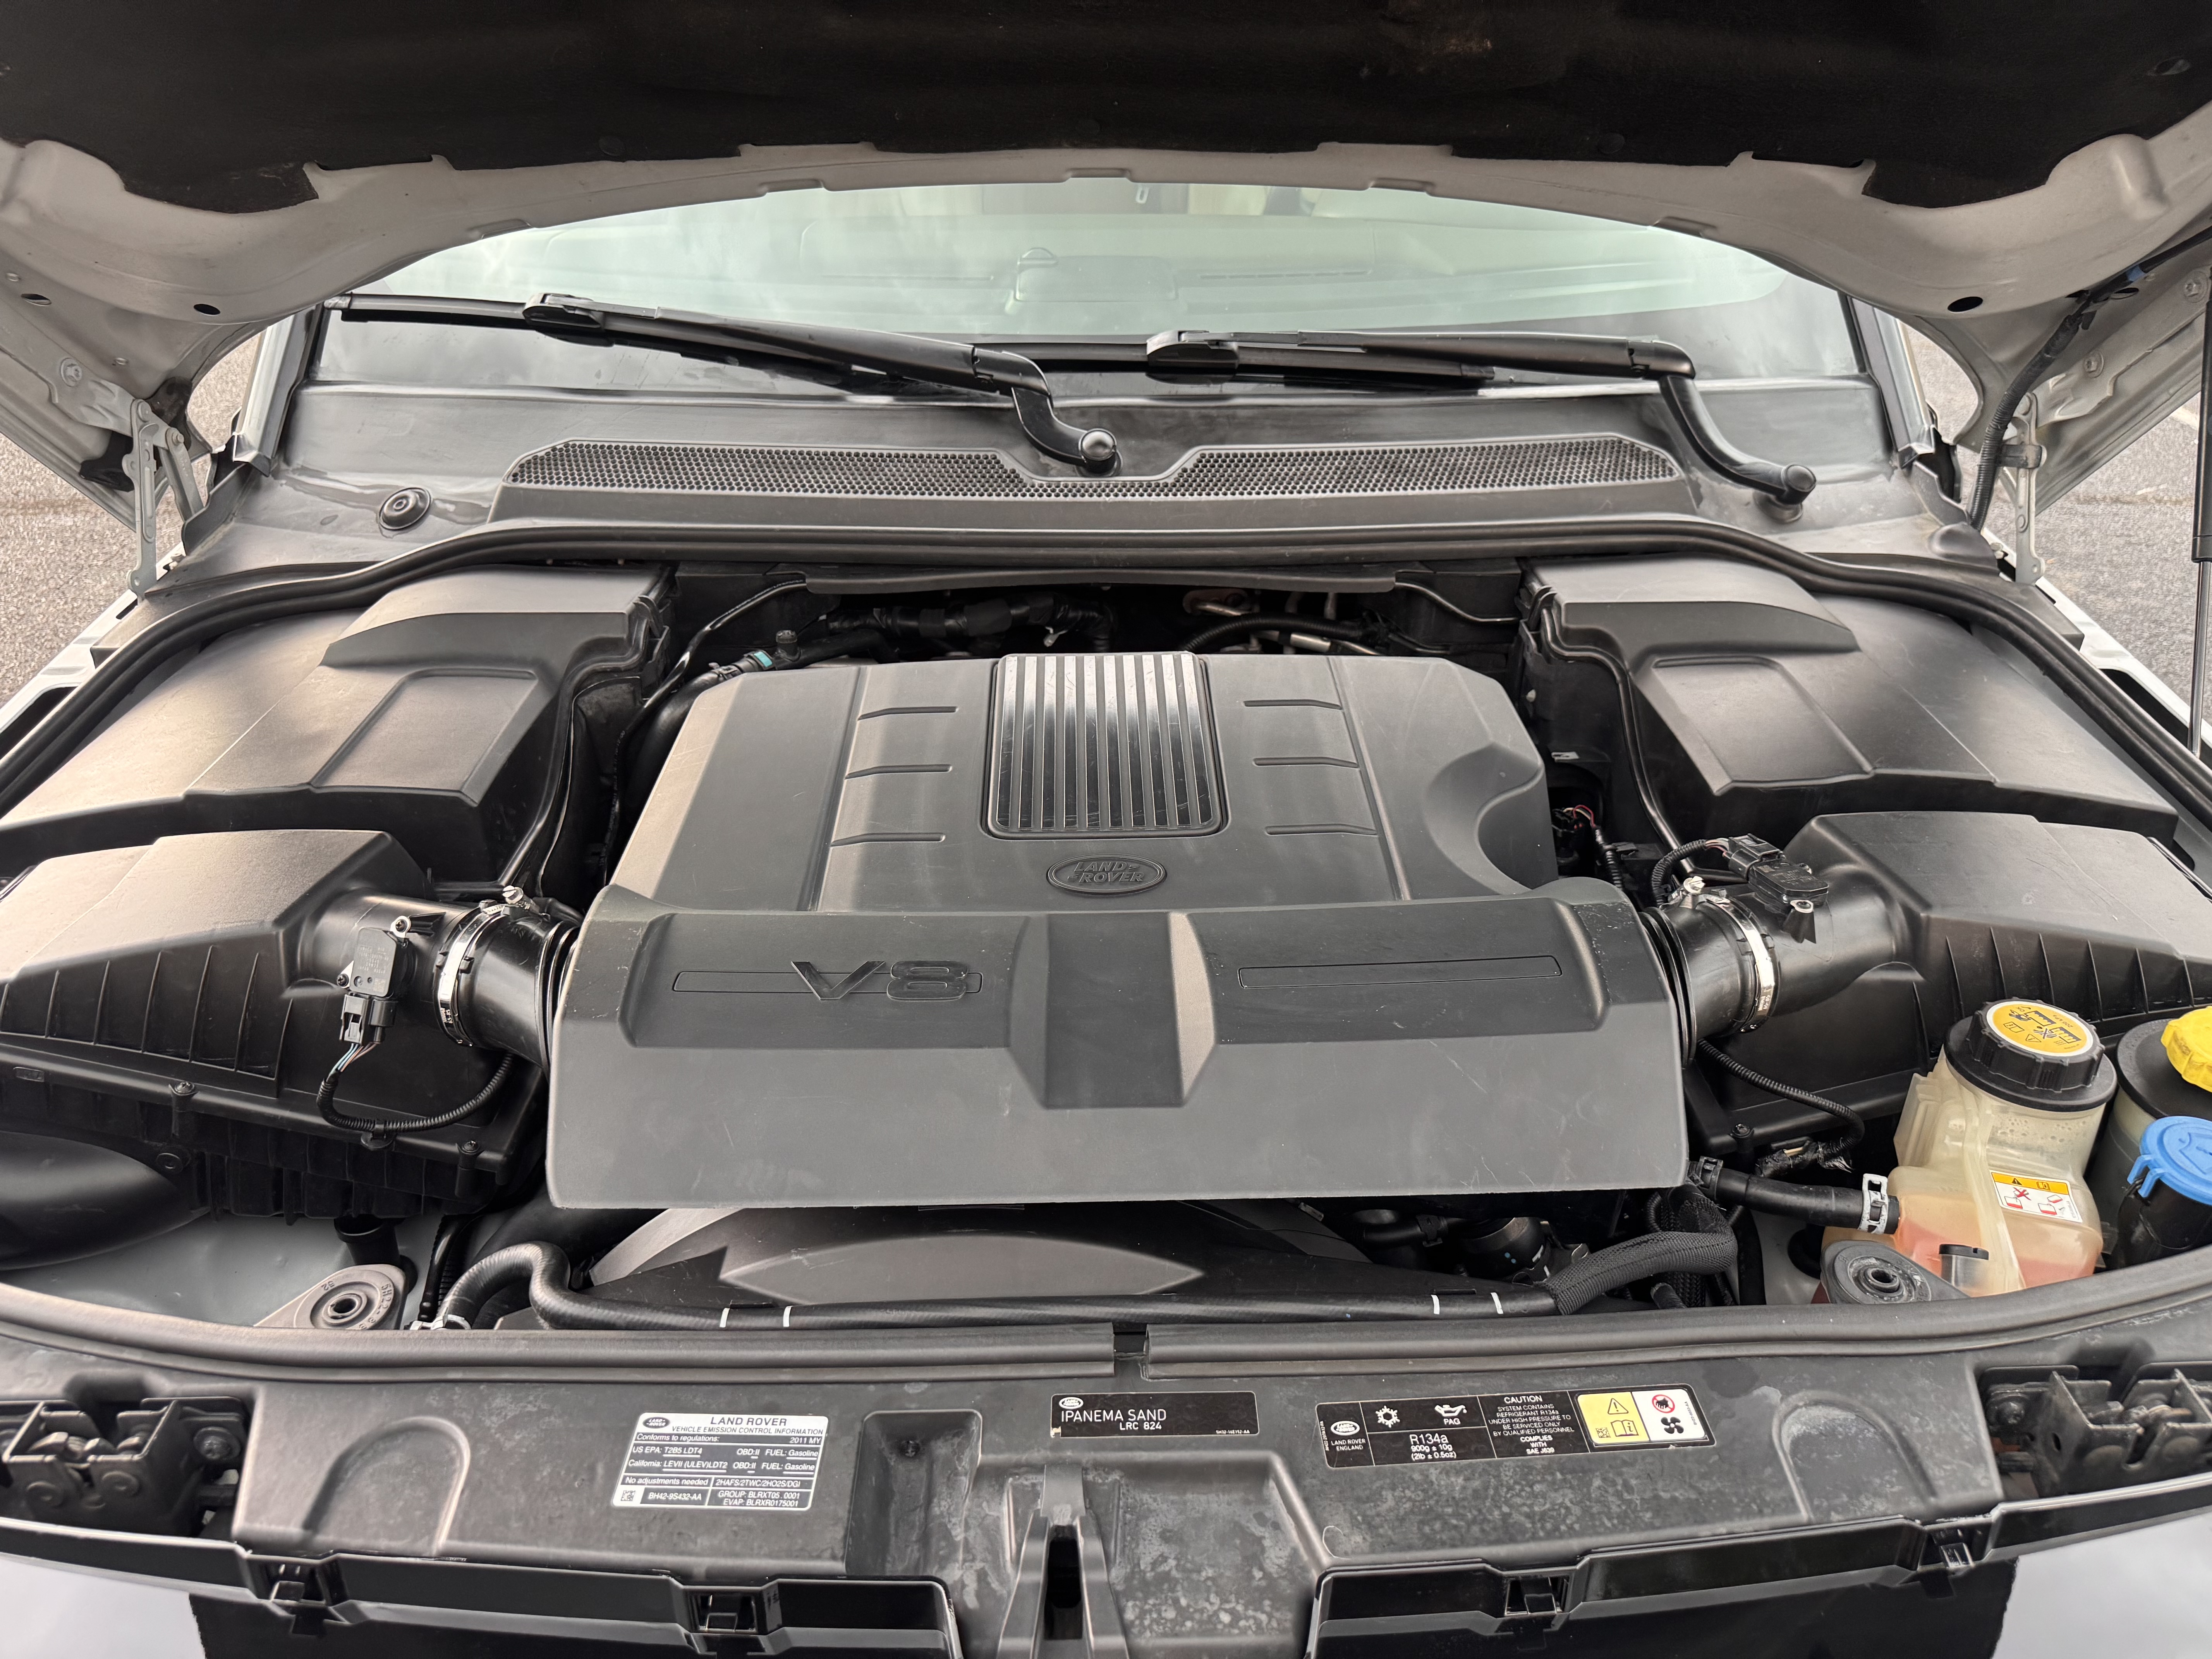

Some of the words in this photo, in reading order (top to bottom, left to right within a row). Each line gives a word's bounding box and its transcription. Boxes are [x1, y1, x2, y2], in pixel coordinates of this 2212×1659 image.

[1074, 861, 1127, 872] LAND
[1079, 872, 1144, 883] ROVER
[791, 960, 969, 1001] V8
[1504, 1395, 1543, 1403] CAUTION
[1061, 1410, 1123, 1422] IPANEMA
[1128, 1409, 1166, 1421] SAND
[710, 1417, 743, 1425] LAND
[746, 1418, 787, 1426] ROVER
[1120, 1422, 1139, 1430] LRC
[1144, 1422, 1162, 1430] 824
[1409, 1433, 1449, 1444] R134a
[1411, 1444, 1430, 1453] 900g
[1411, 1453, 1425, 1461] (2lb
[637, 1477, 680, 1485] adjustments
